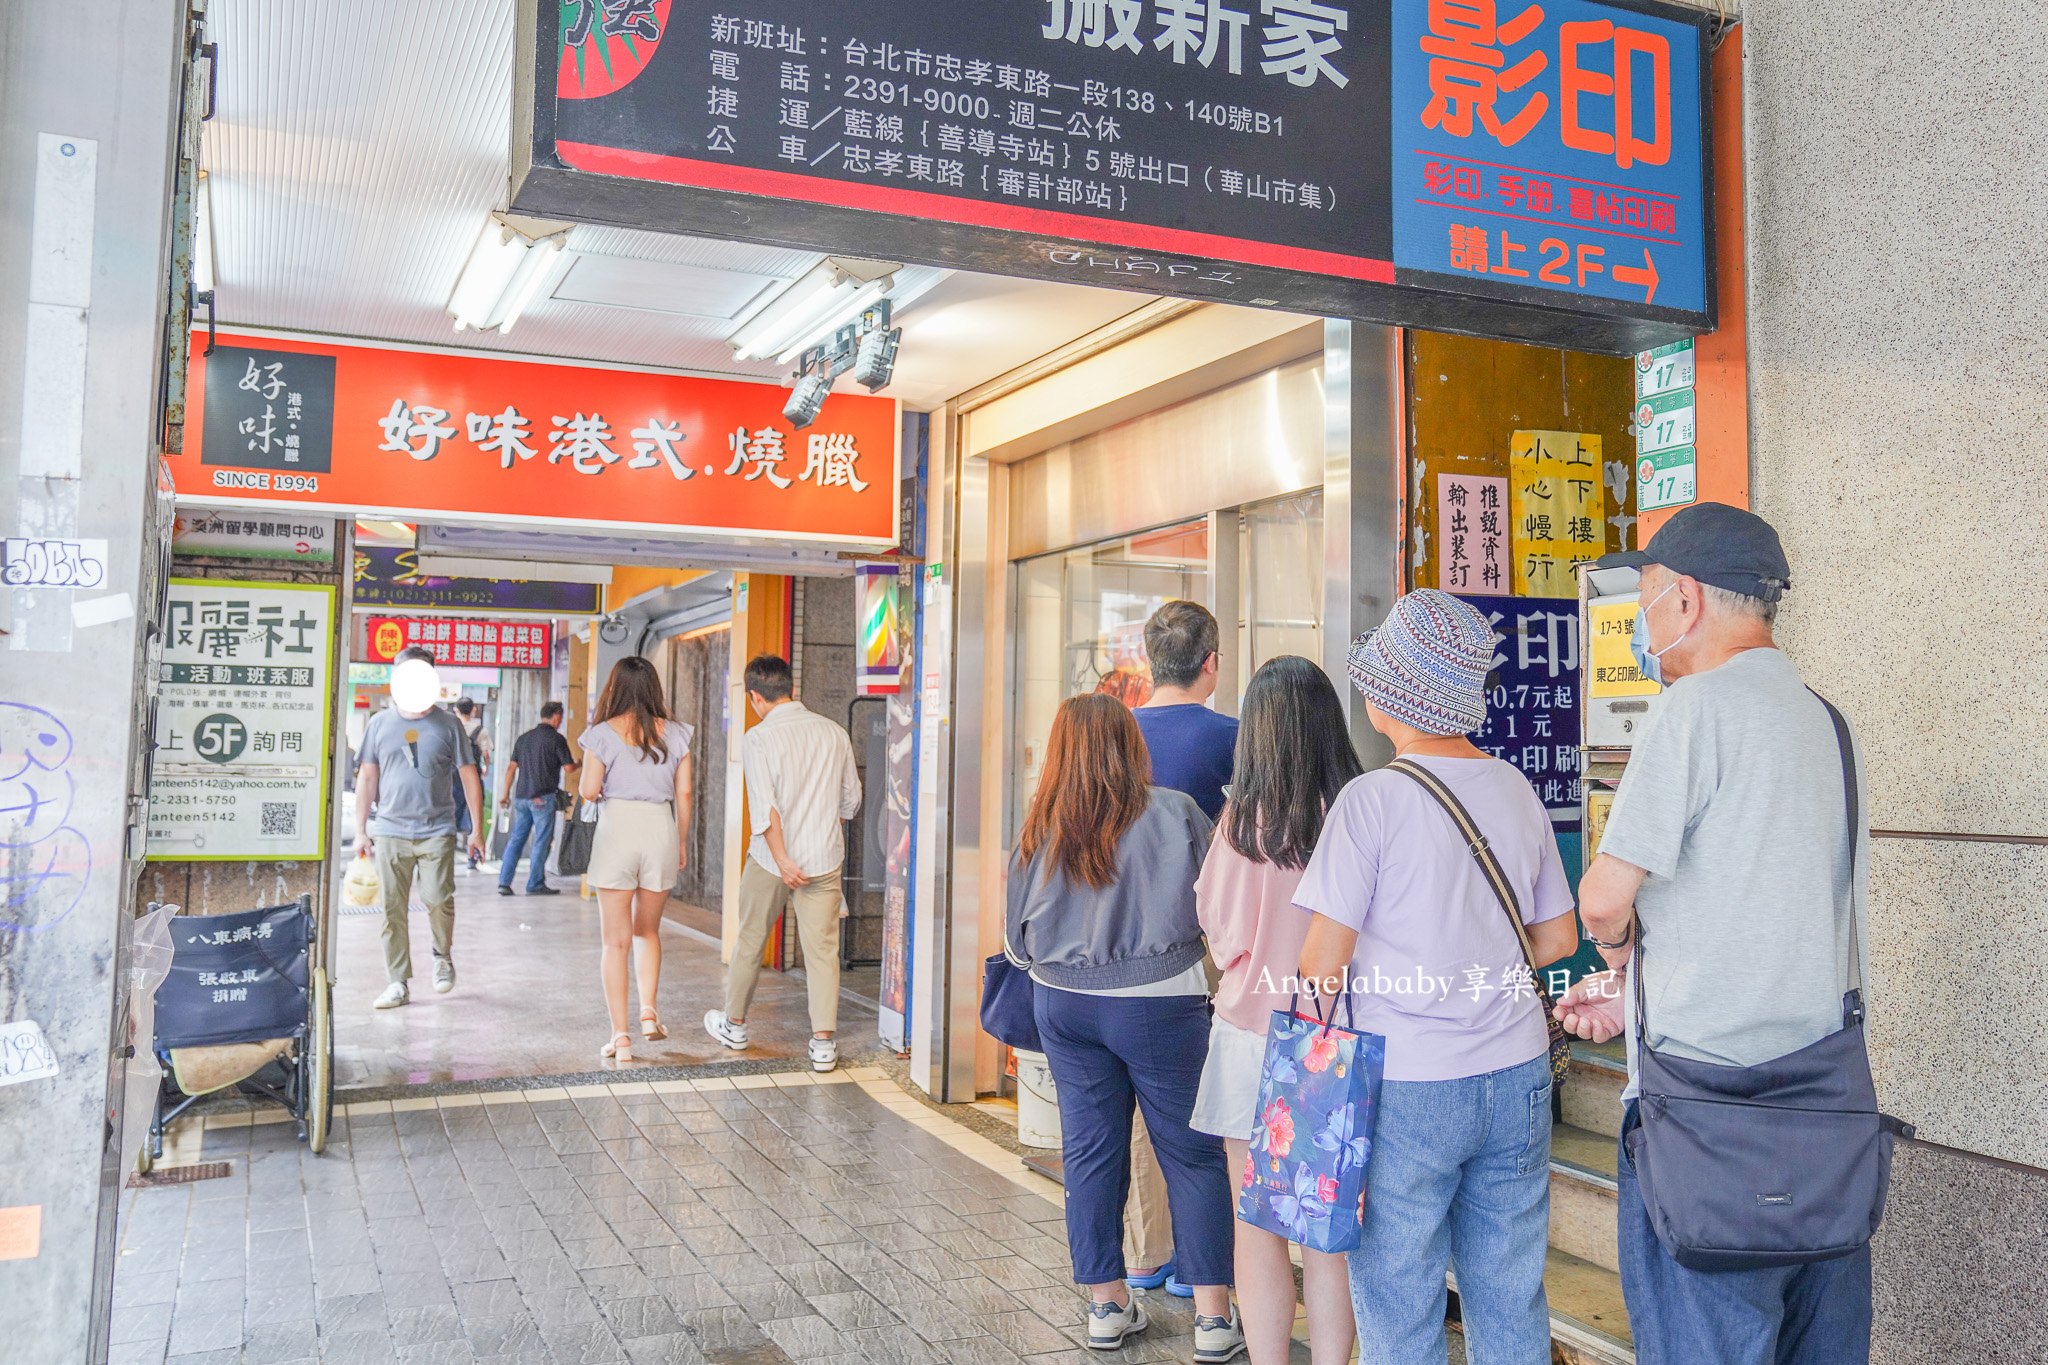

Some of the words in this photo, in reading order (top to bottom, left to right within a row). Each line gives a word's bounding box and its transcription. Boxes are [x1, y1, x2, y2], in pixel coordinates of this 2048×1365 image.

[1420, 0, 1671, 169] 影印
[1656, 363, 1675, 389] 17
[238, 356, 287, 454] 好味
[1656, 420, 1676, 445] 17
[214, 470, 269, 489] SINCE
[274, 475, 317, 492] 1994
[1657, 477, 1676, 501] 17
[1524, 438, 1554, 580] 小心慢行
[192, 518, 324, 540] 澳洲留學顧問中心
[1480, 484, 1502, 589] 推甄資料
[1600, 620, 1622, 635] 17-3
[161, 729, 183, 750] 上
[200, 722, 243, 756] 5F
[253, 731, 302, 753] 詢問
